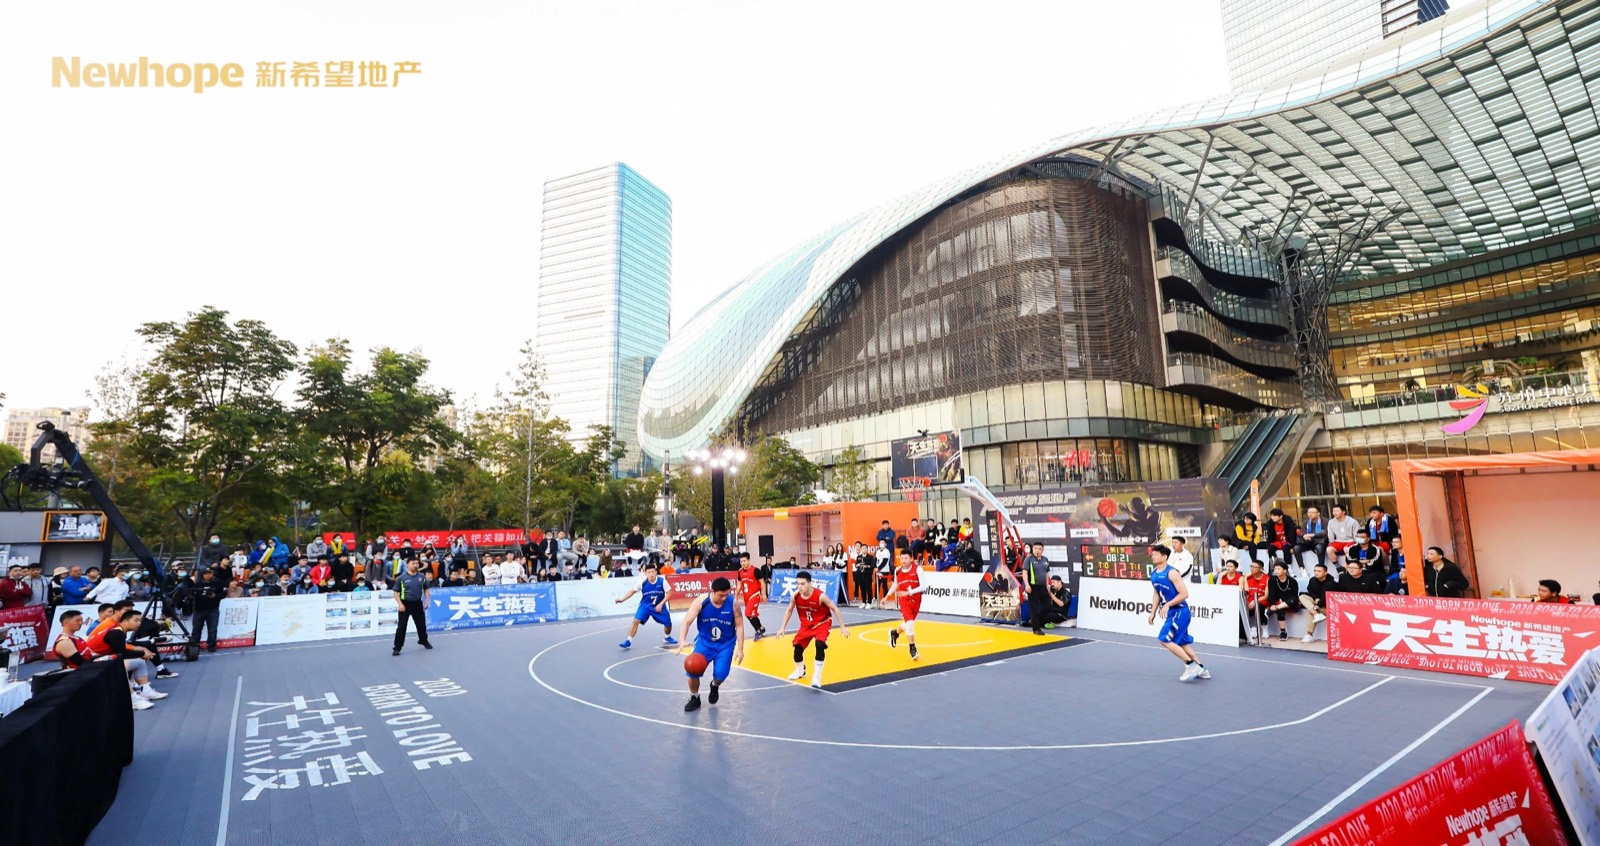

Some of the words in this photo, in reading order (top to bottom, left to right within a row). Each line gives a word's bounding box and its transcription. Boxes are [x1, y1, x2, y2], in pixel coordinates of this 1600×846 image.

[1498, 402, 1539, 413] SUZHOU
[1541, 397, 1584, 407] CENTER
[59, 516, 98, 537] 温州
[1106, 554, 1129, 562] 08:21
[1087, 562, 1094, 575] 2
[1114, 563, 1126, 577] 12
[674, 581, 701, 592] 32500
[743, 583, 749, 593] 3
[922, 586, 950, 597] whope
[449, 595, 536, 620] 天生热爱
[650, 596, 658, 605] 7
[1089, 595, 1153, 615] Newhope
[1436, 600, 1460, 609] BORN
[711, 626, 722, 642] 9
[1470, 615, 1521, 628] Newhope
[1523, 622, 1571, 634] 新希望地产
[1370, 609, 1567, 666] 天生热爱
[361, 683, 419, 710] BORN
[413, 677, 468, 698] 2020
[380, 706, 434, 725] TO
[392, 723, 473, 771] LOVE
[1445, 804, 1491, 838] Newhope
[1488, 790, 1519, 818] 新希望地产
